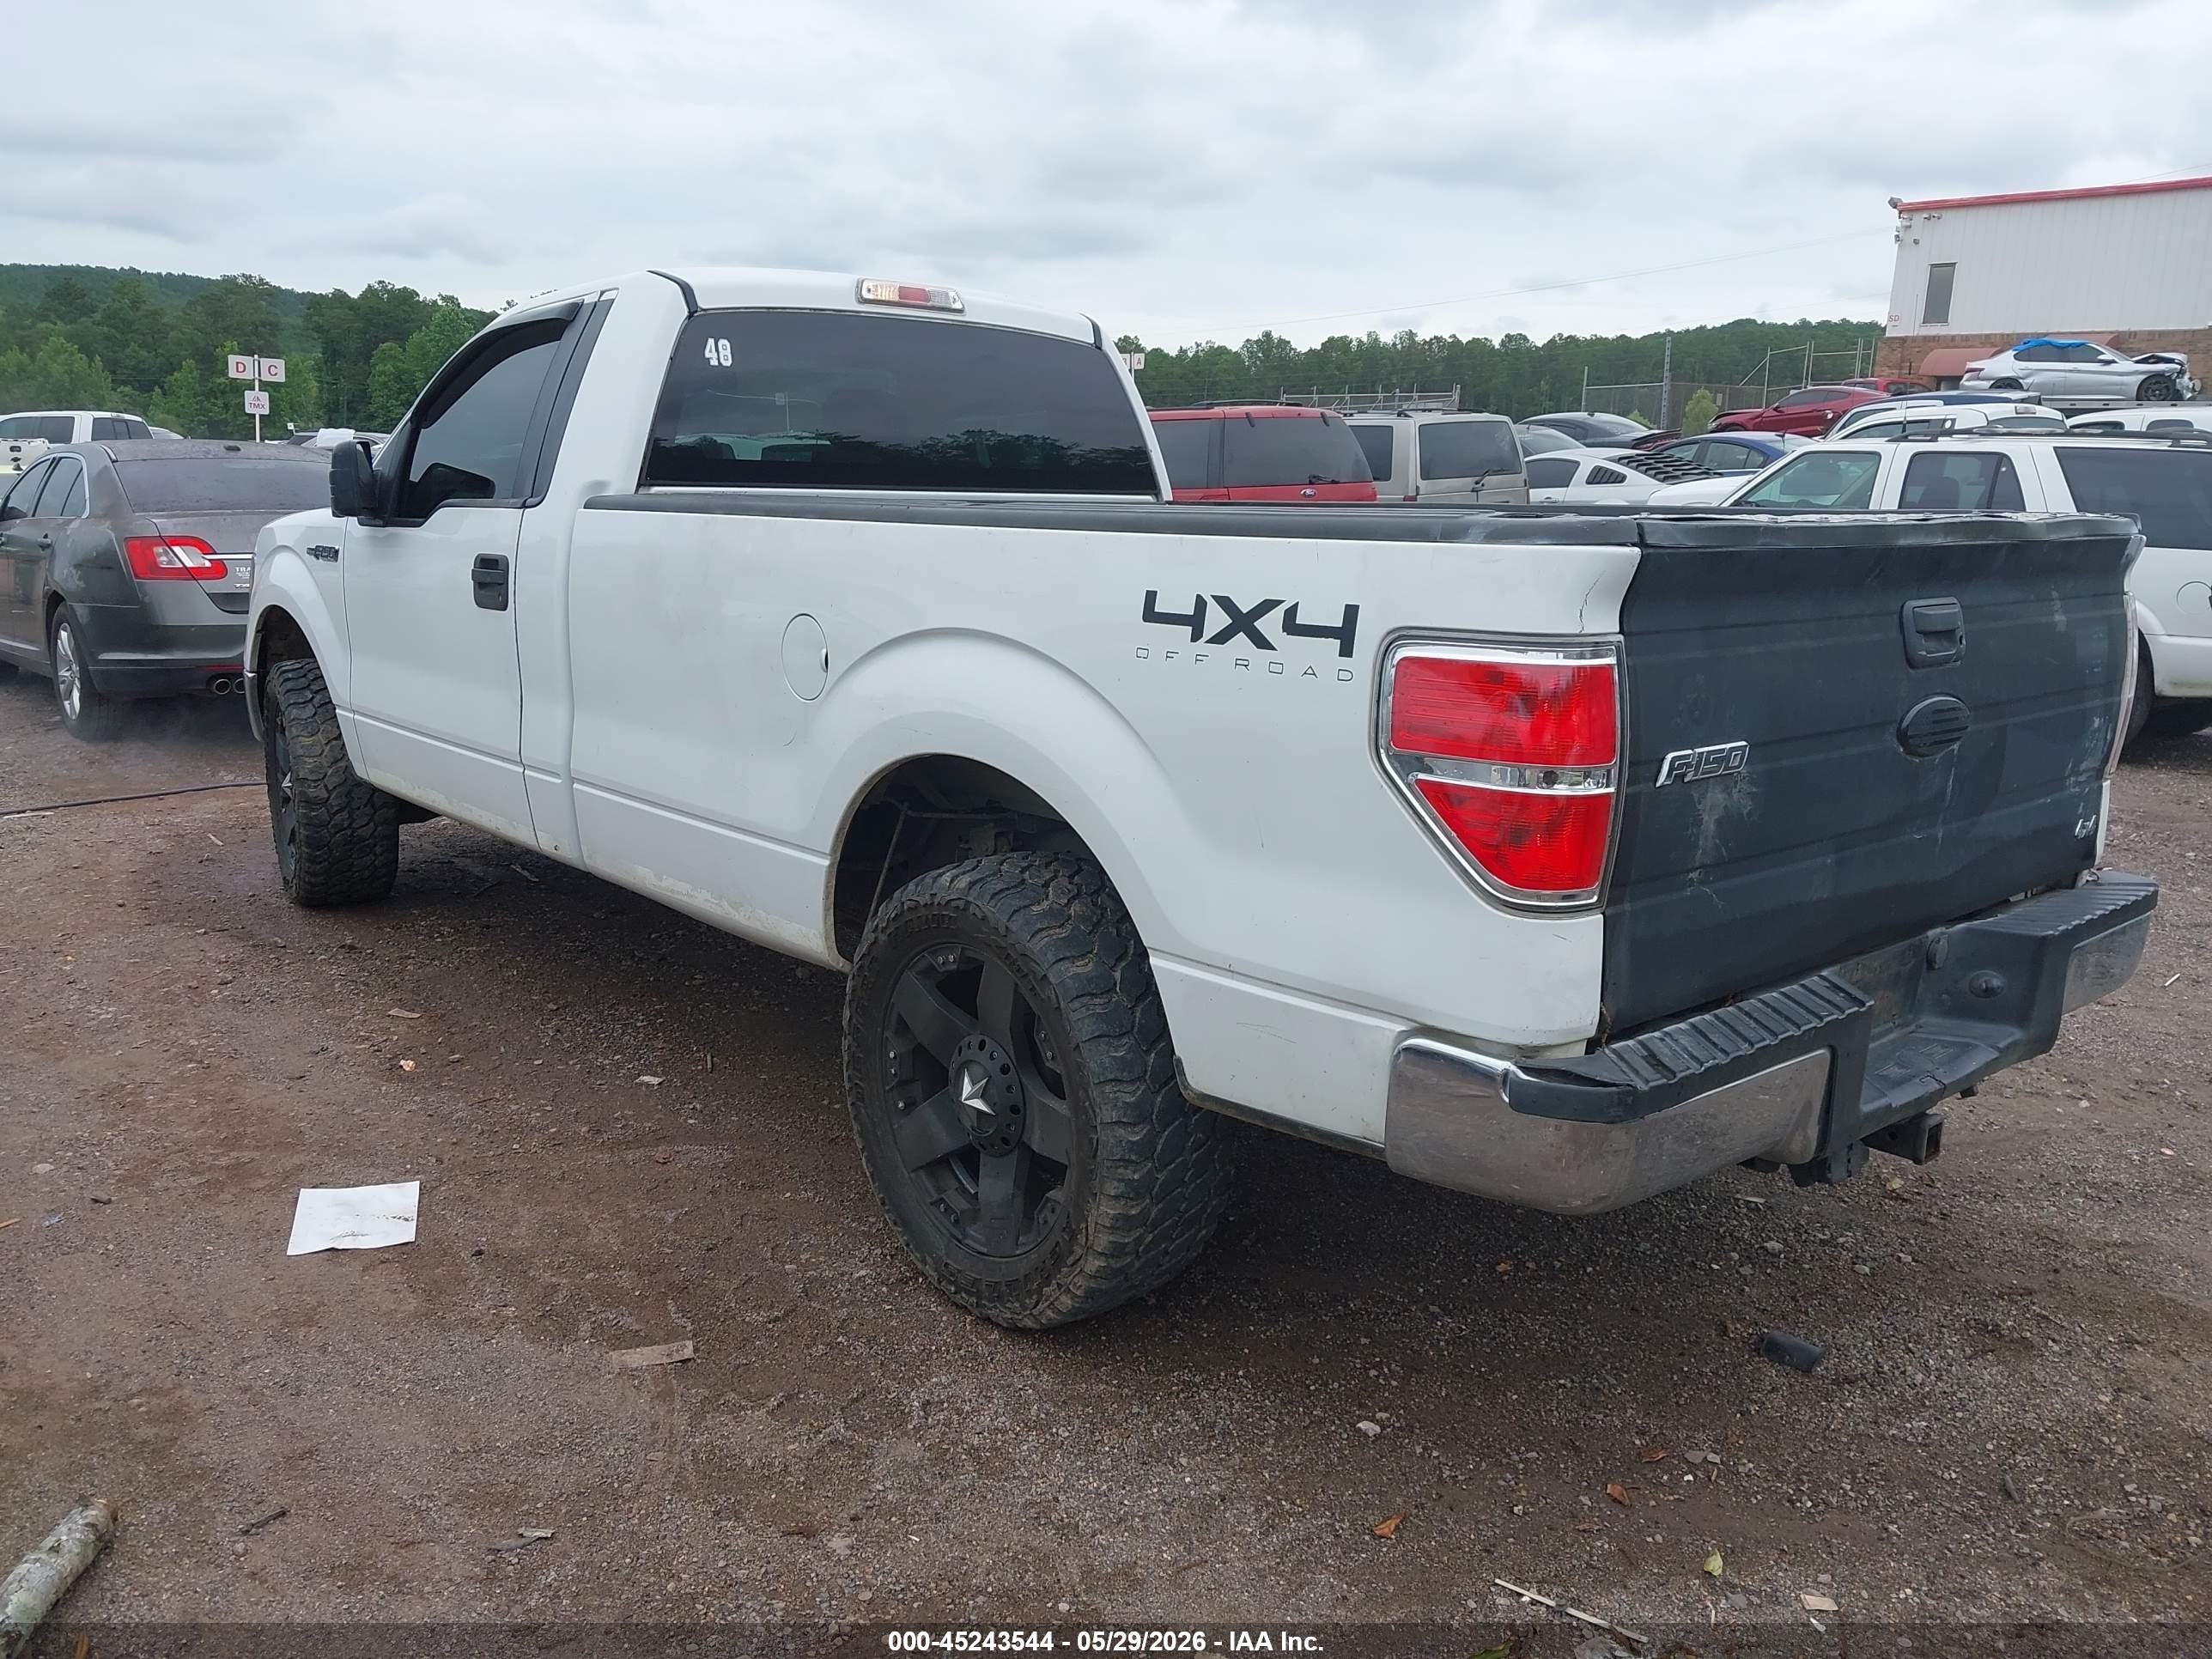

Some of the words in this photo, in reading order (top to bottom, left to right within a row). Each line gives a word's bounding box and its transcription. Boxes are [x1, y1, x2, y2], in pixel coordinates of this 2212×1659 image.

[704, 337, 732, 367] 48
[1136, 357, 1141, 366] A
[235, 362, 246, 374] D
[268, 364, 278, 376] C
[1142, 589, 1360, 659] 4X4
